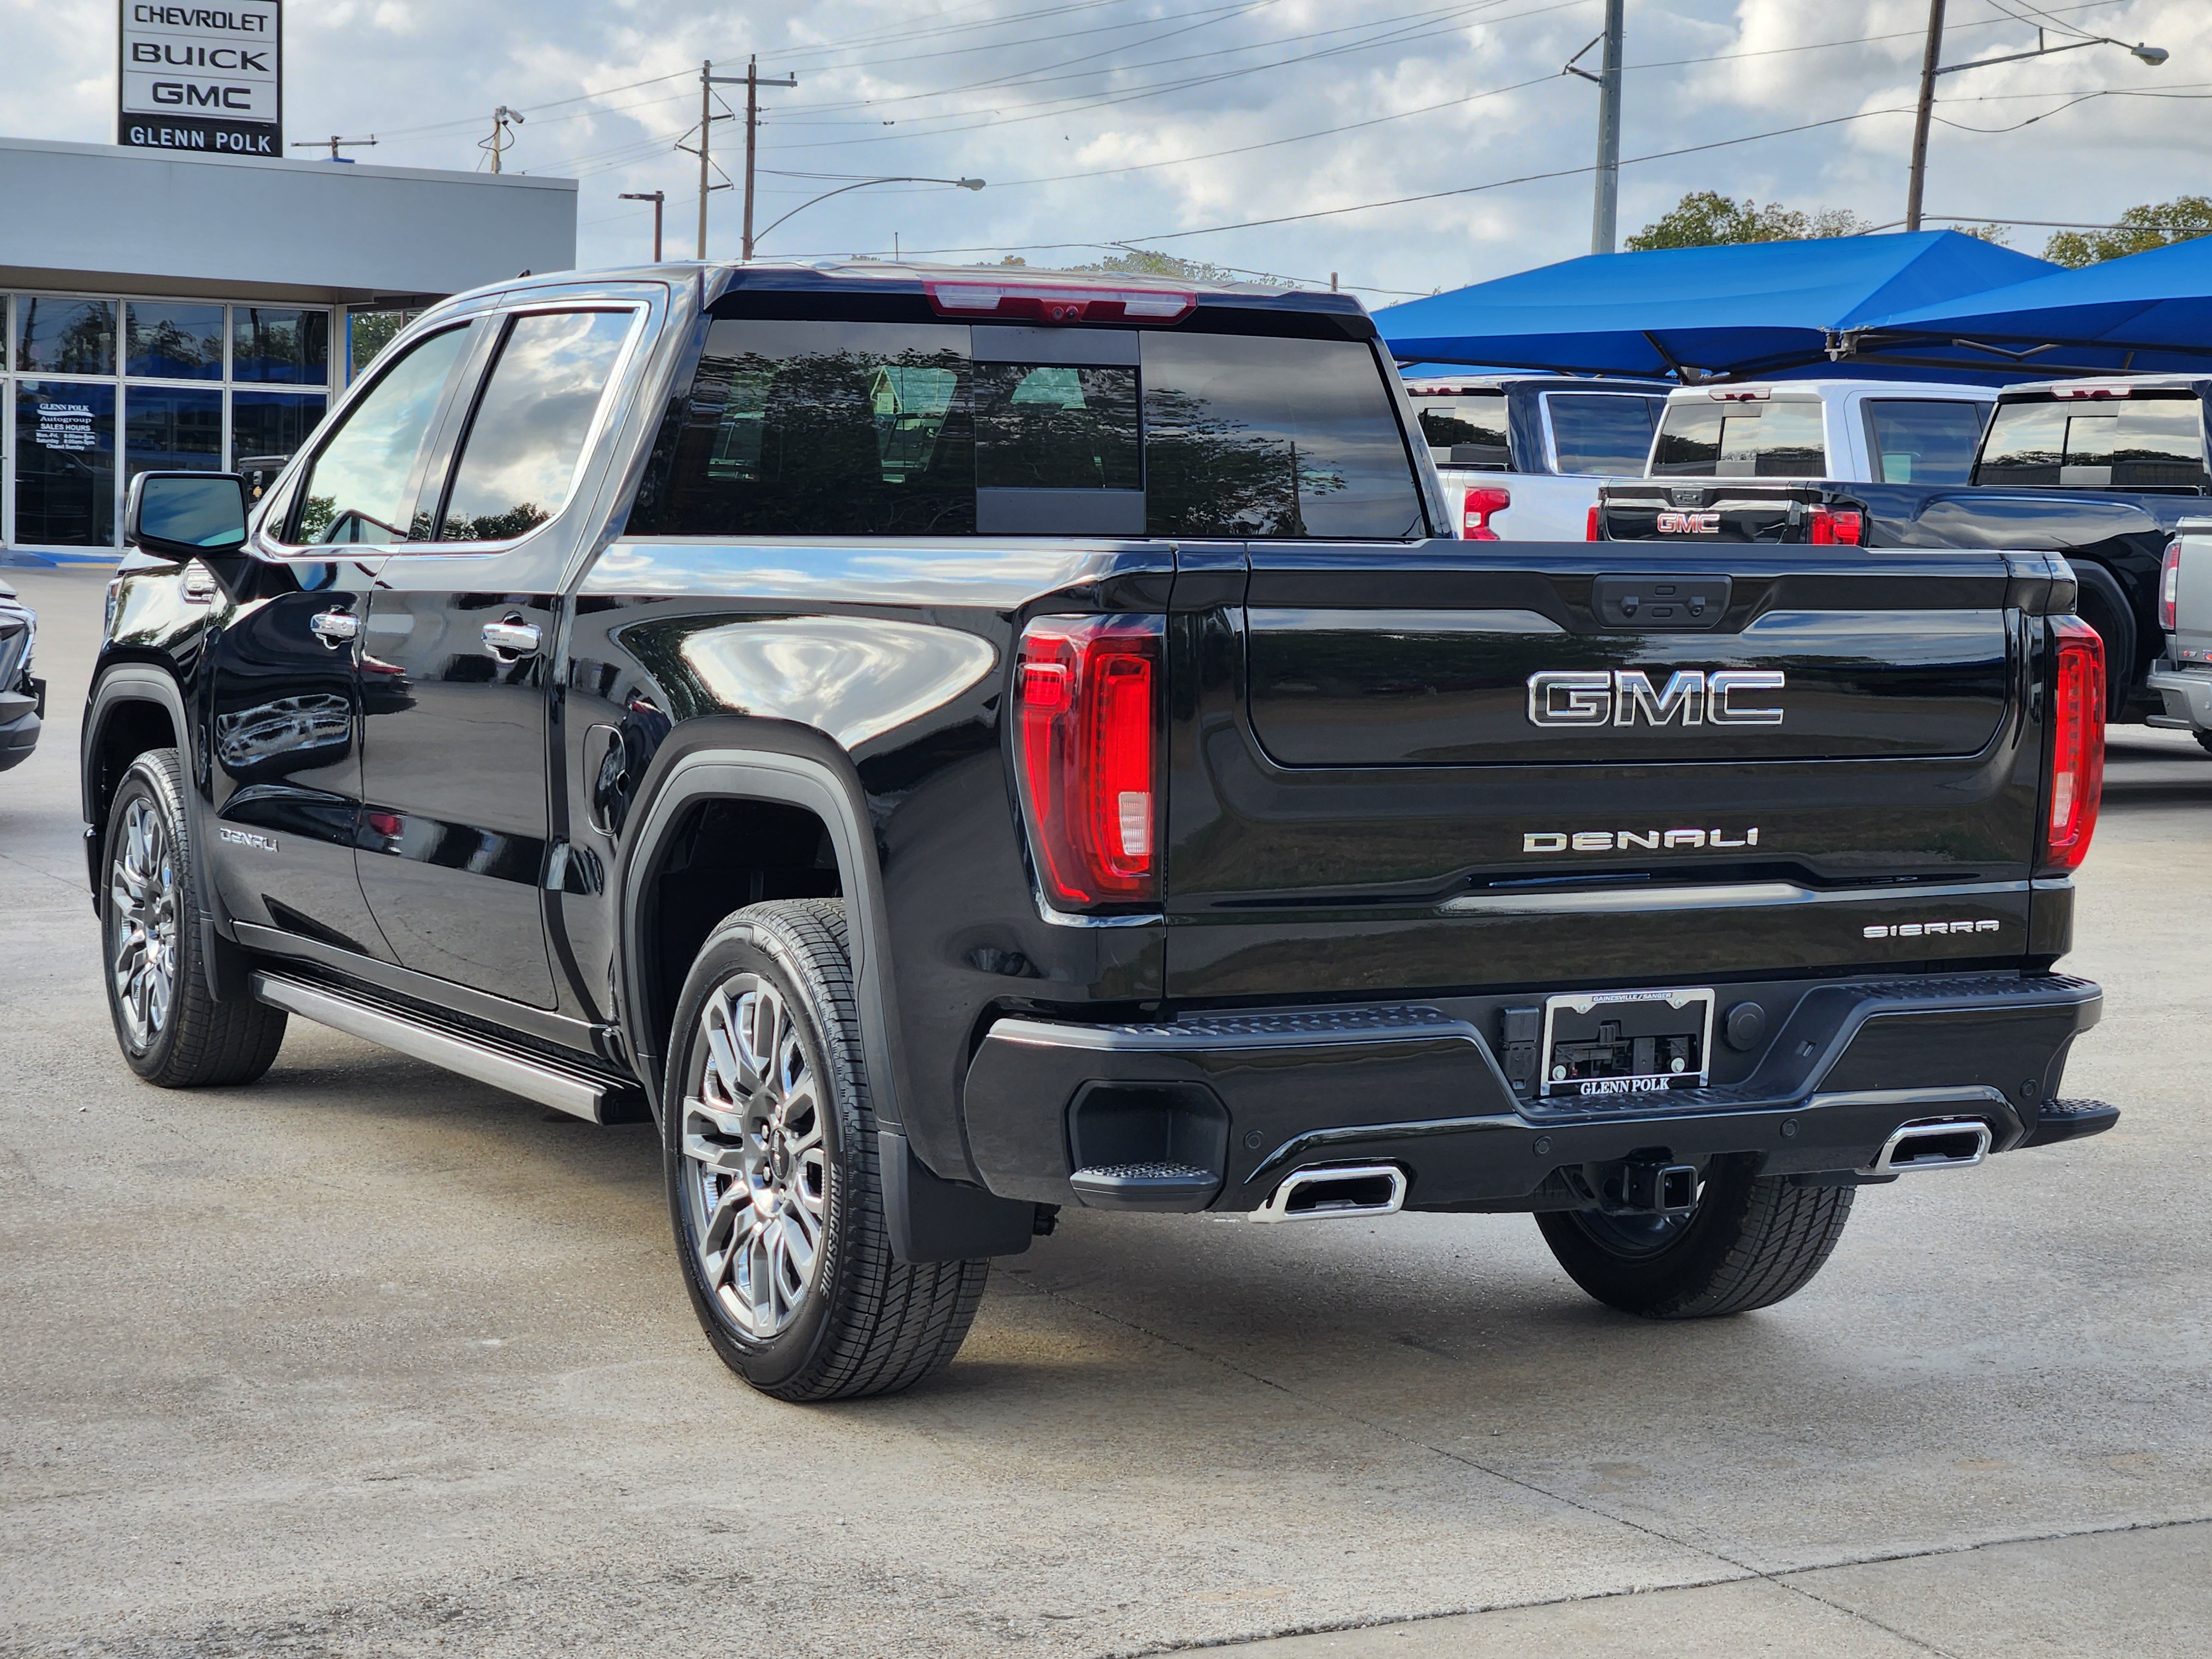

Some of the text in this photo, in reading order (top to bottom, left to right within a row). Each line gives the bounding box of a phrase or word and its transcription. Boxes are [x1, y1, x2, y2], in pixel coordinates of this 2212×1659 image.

[134, 4, 268, 32] CHEVROLET
[132, 43, 270, 72] BUICK
[152, 82, 251, 110] GMC
[130, 126, 272, 153] GLENN POLK
[1657, 513, 1720, 534] GMC
[1526, 670, 1785, 727] GMC
[220, 827, 279, 852] DENALI
[1523, 827, 1759, 852] DENALI
[1863, 919, 2000, 938] SIERRA
[1593, 993, 1671, 1001] GAINESVILLE/SANGER
[1580, 1078, 1670, 1095] GLENN POLK
[820, 1162, 843, 1300] BRIDGESTONE
